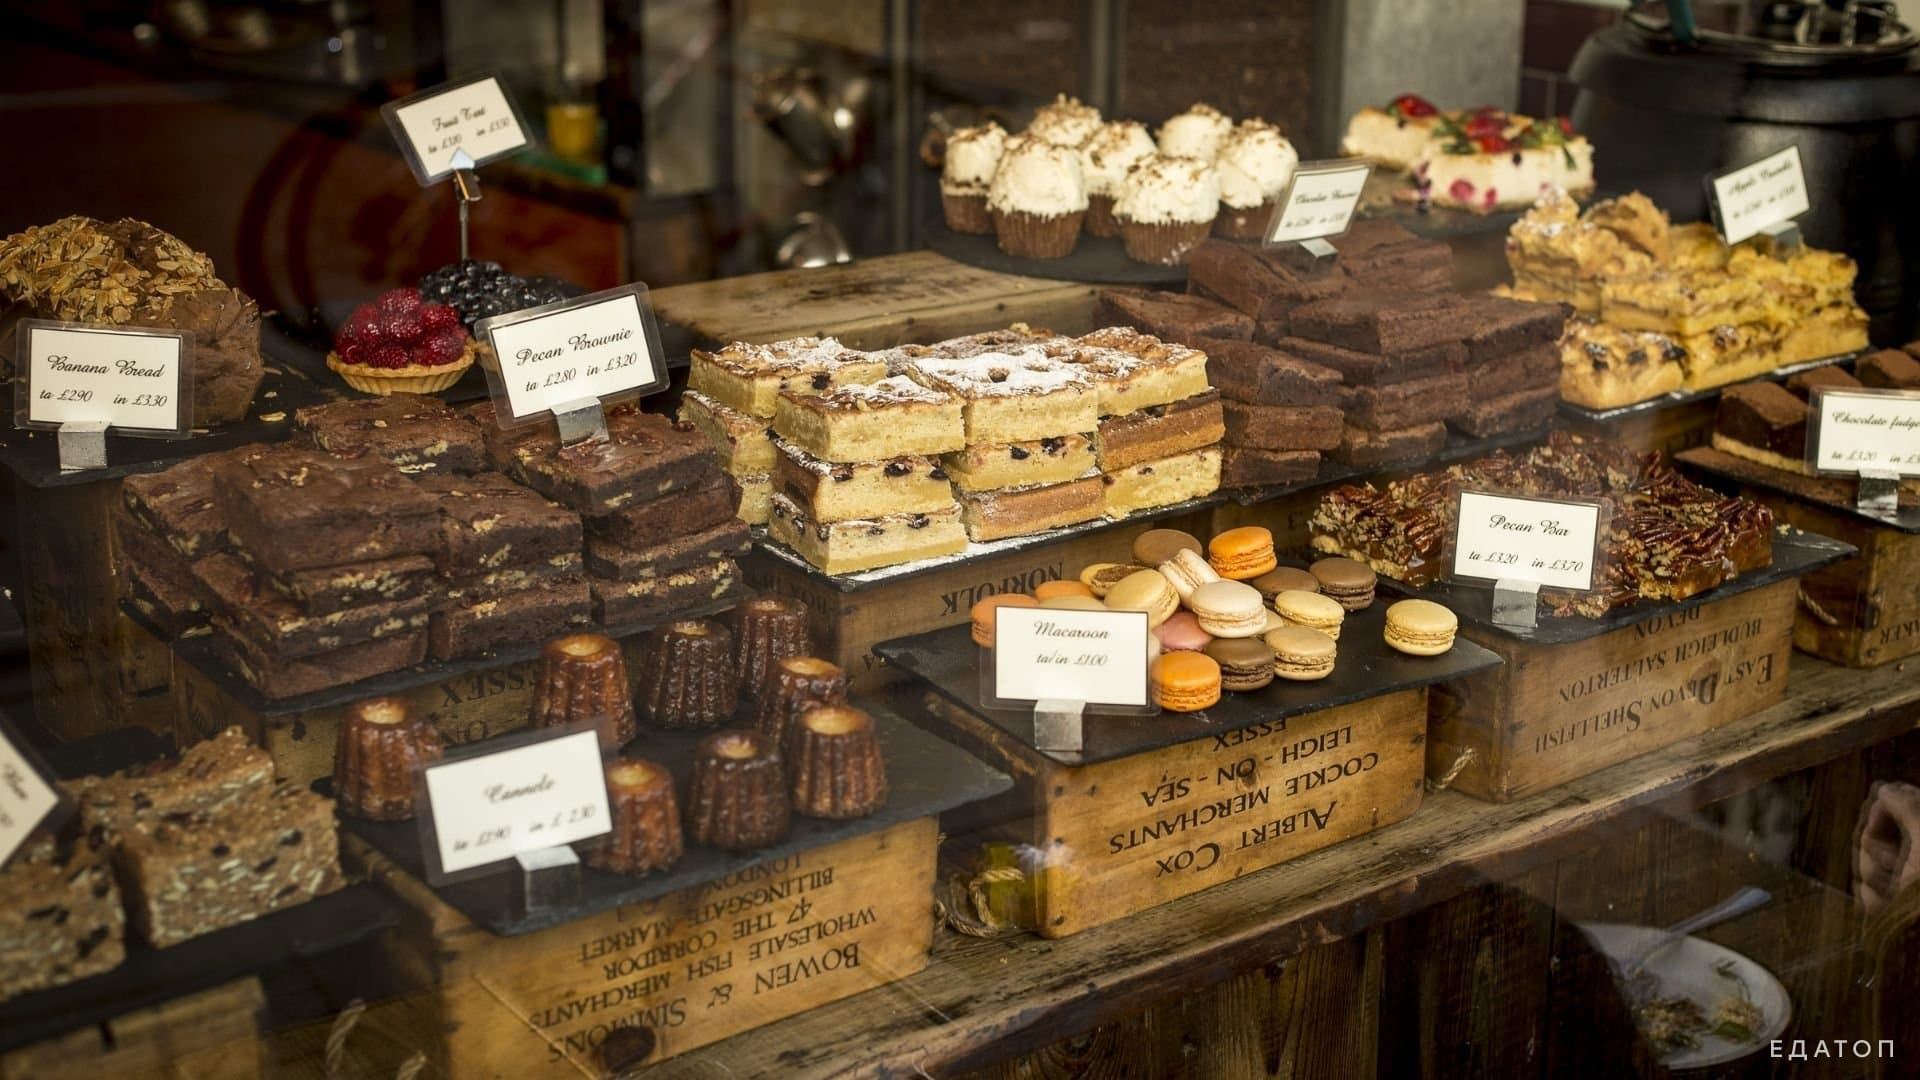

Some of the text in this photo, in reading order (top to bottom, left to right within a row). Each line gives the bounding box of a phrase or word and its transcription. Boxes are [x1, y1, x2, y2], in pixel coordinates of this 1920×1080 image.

[516, 328, 633, 366] Pecan Brownie
[48, 355, 165, 378] Banana Bread
[525, 381, 538, 392] ta
[586, 366, 600, 376] in
[39, 390, 53, 399] ta
[113, 394, 128, 404] in
[1832, 411, 1887, 425] Chocolate
[1489, 514, 1570, 536] Pecan Bar
[1468, 551, 1481, 560] ta
[1531, 558, 1544, 568] in
[1034, 621, 1110, 639] Macaroon
[1557, 618, 1761, 703] BUDLEIGH SALTERTON
[1212, 718, 1287, 752] ESSEX
[1281, 726, 1352, 764] LEIGH
[1217, 758, 1256, 785] ON
[1109, 752, 1378, 855] COCKLE MERCHANTS
[1141, 778, 1190, 807] SEA
[1155, 801, 1337, 878] ALBERT COX
[687, 867, 834, 928] BILLINGSGATE
[576, 919, 671, 963] MARKET
[602, 896, 812, 981] 47 THE CORRIDOR
[748, 905, 876, 960] WHOLESALE
[686, 951, 733, 981] FISH
[754, 942, 860, 994] BOWEN
[708, 983, 732, 1007] &
